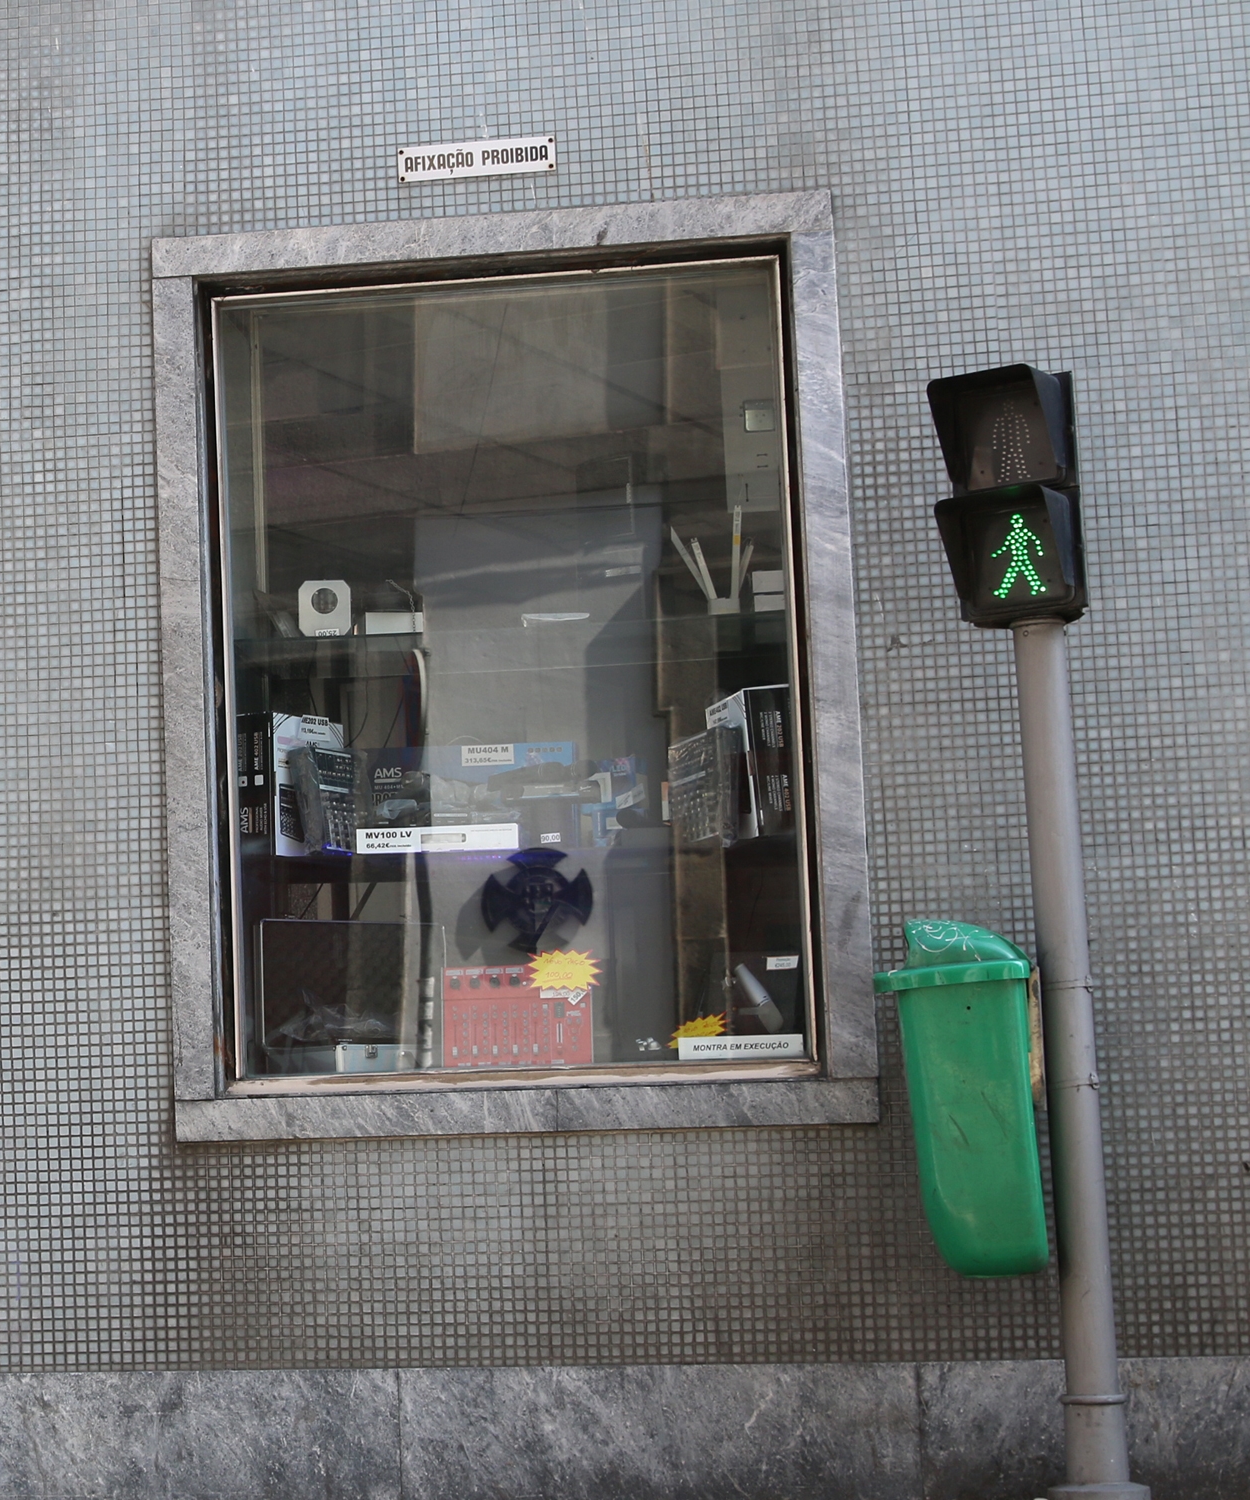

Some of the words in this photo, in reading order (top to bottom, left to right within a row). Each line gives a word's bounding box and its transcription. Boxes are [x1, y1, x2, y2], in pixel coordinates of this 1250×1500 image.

[404, 149, 474, 175] AFIXAÇÃO
[482, 145, 548, 166] PROIBIDA
[374, 767, 402, 778] AMS
[240, 807, 249, 833] AMS
[365, 831, 397, 839] MV100
[693, 1043, 728, 1051] MONTRA
[744, 1042, 789, 1051] EXECUÇÃO
